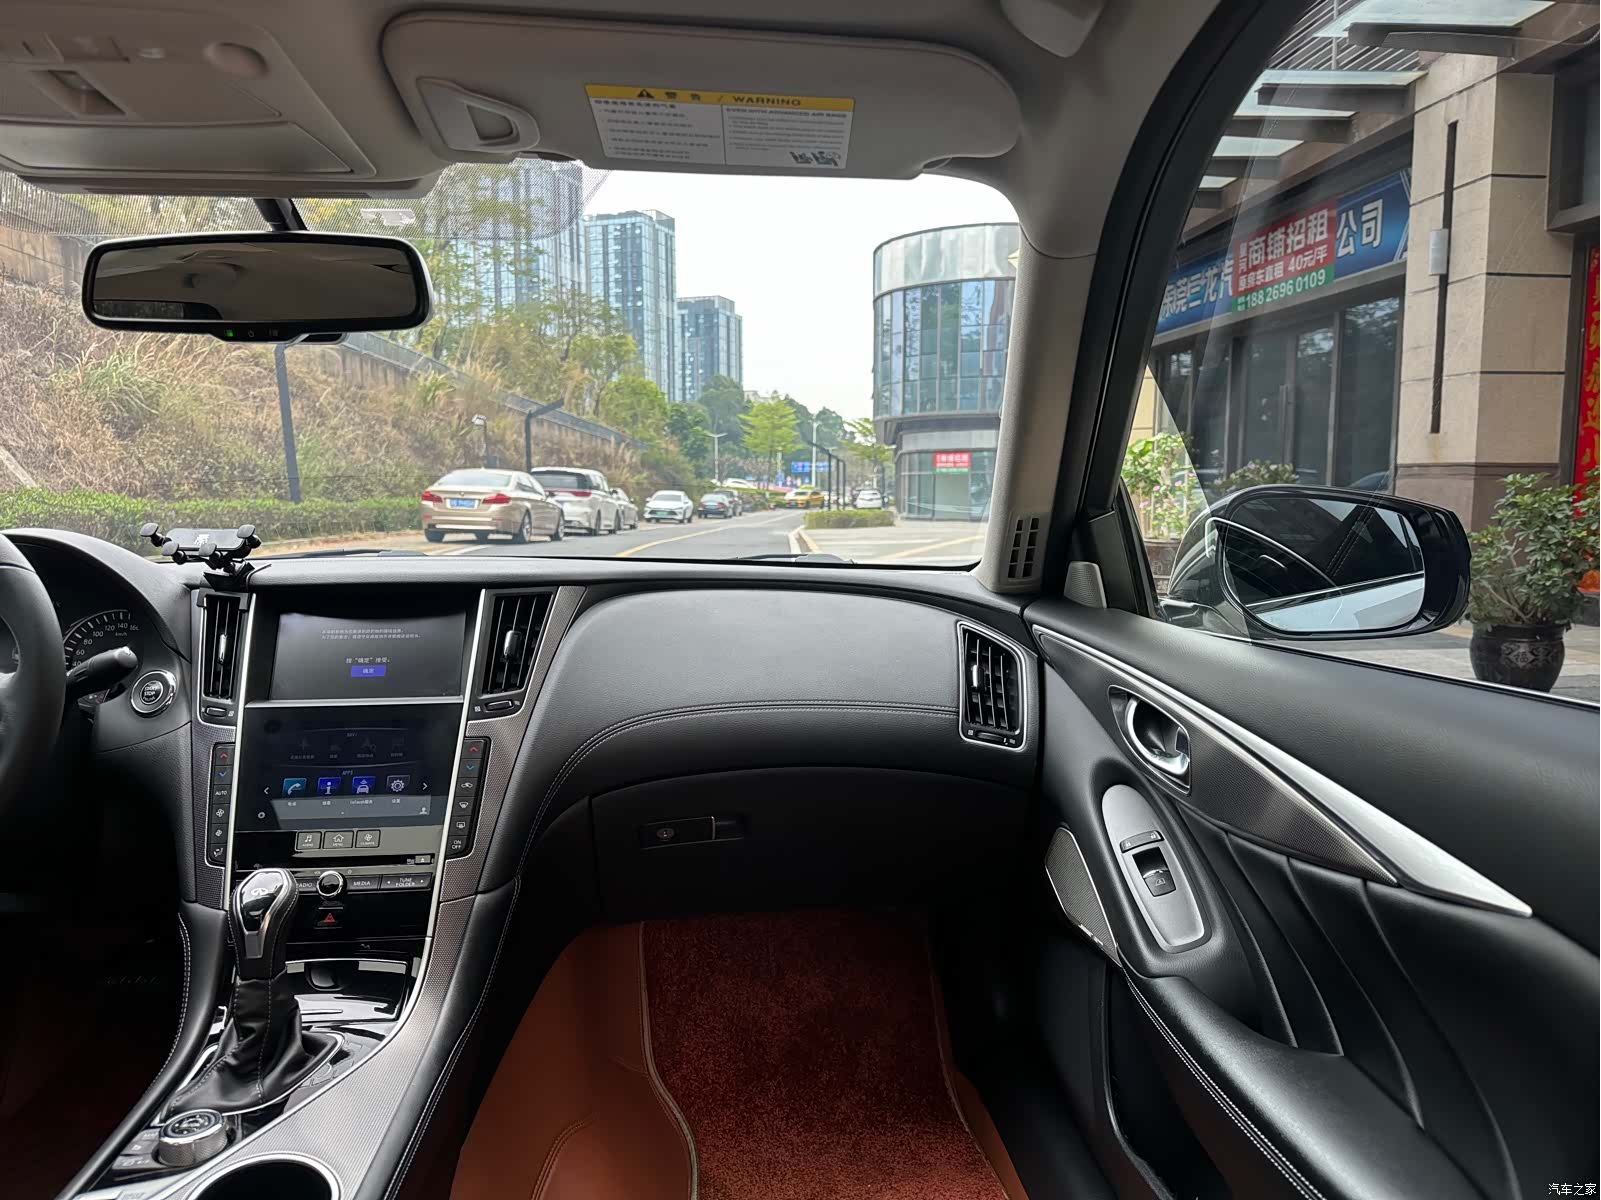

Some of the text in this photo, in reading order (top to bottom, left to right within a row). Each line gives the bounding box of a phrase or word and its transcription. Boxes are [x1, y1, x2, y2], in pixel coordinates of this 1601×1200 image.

[732, 95, 802, 107] WARNING
[1336, 198, 1384, 258] 公司
[1248, 208, 1329, 269] 商铺招租
[1287, 244, 1328, 273] 40元/平
[1246, 290, 1265, 308] 188
[1265, 280, 1294, 303] 2696
[1295, 268, 1326, 292] 0109
[92, 630, 104, 638] 100
[105, 624, 115, 632] 120
[75, 648, 85, 656] 60
